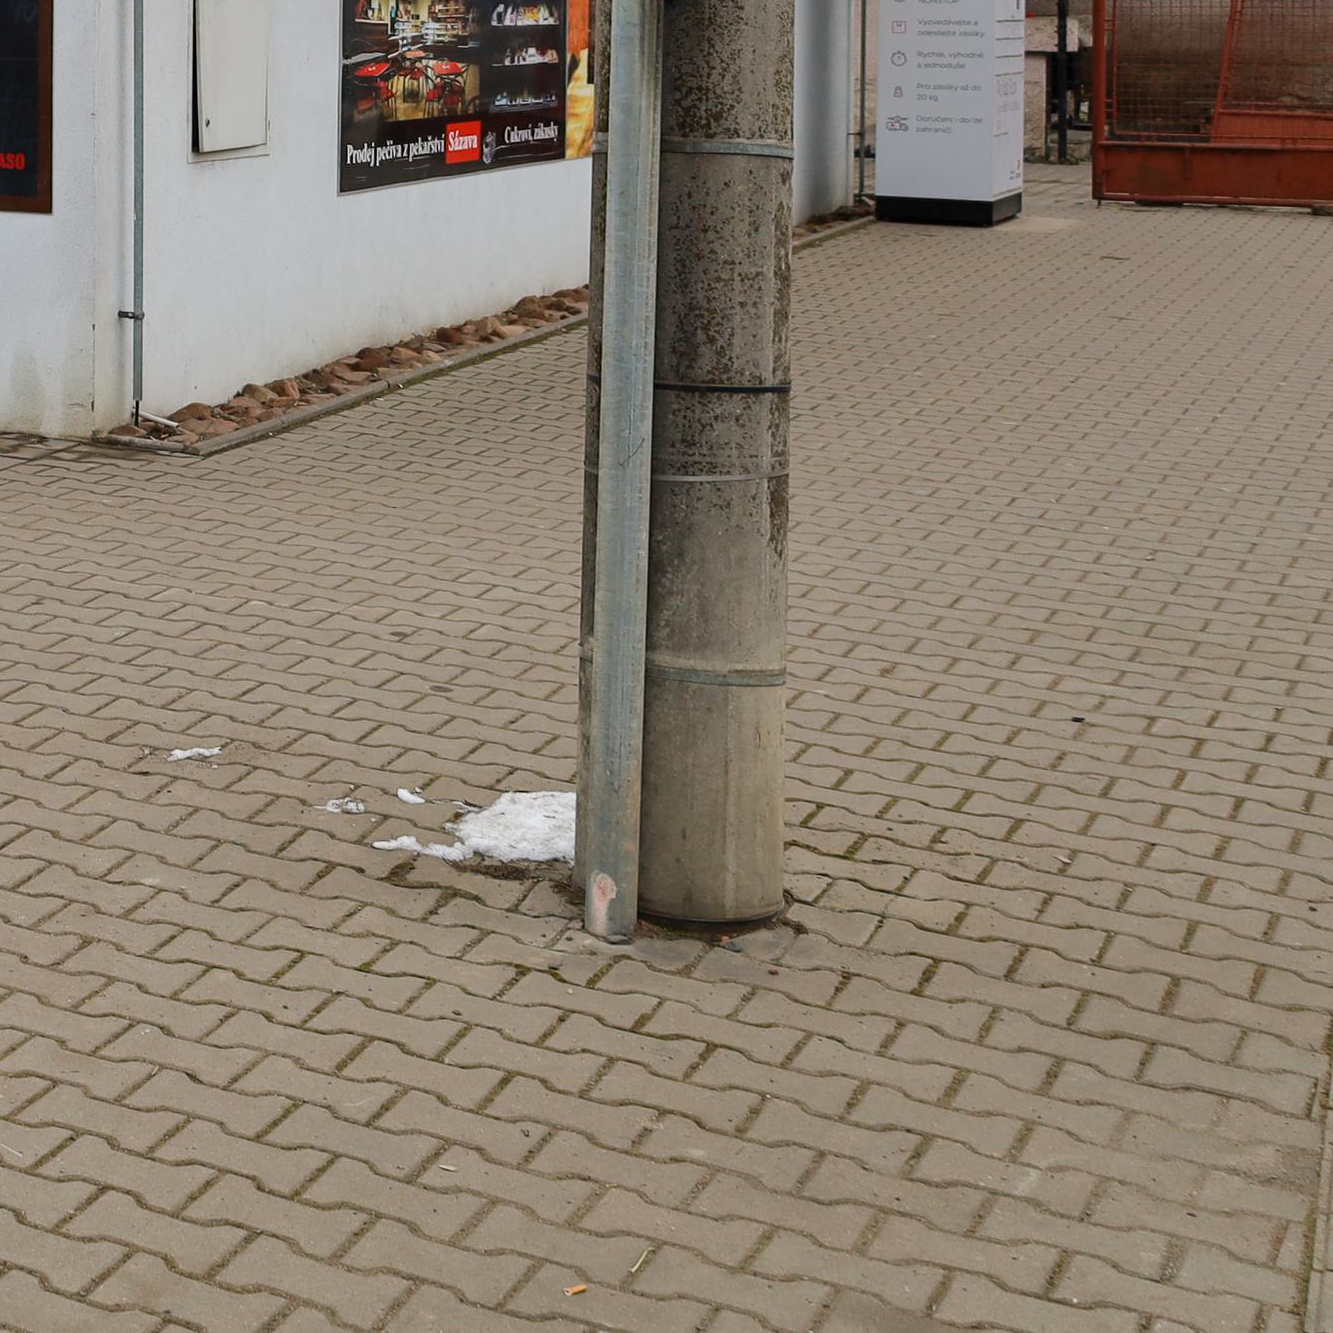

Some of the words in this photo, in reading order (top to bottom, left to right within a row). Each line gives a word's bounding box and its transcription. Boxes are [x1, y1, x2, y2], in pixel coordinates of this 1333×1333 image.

[346, 143, 375, 167] Prodej
[376, 141, 403, 166] pečiva
[409, 134, 444, 162] pekařství
[448, 130, 478, 152] Sázava
[533, 122, 558, 142] zákusky
